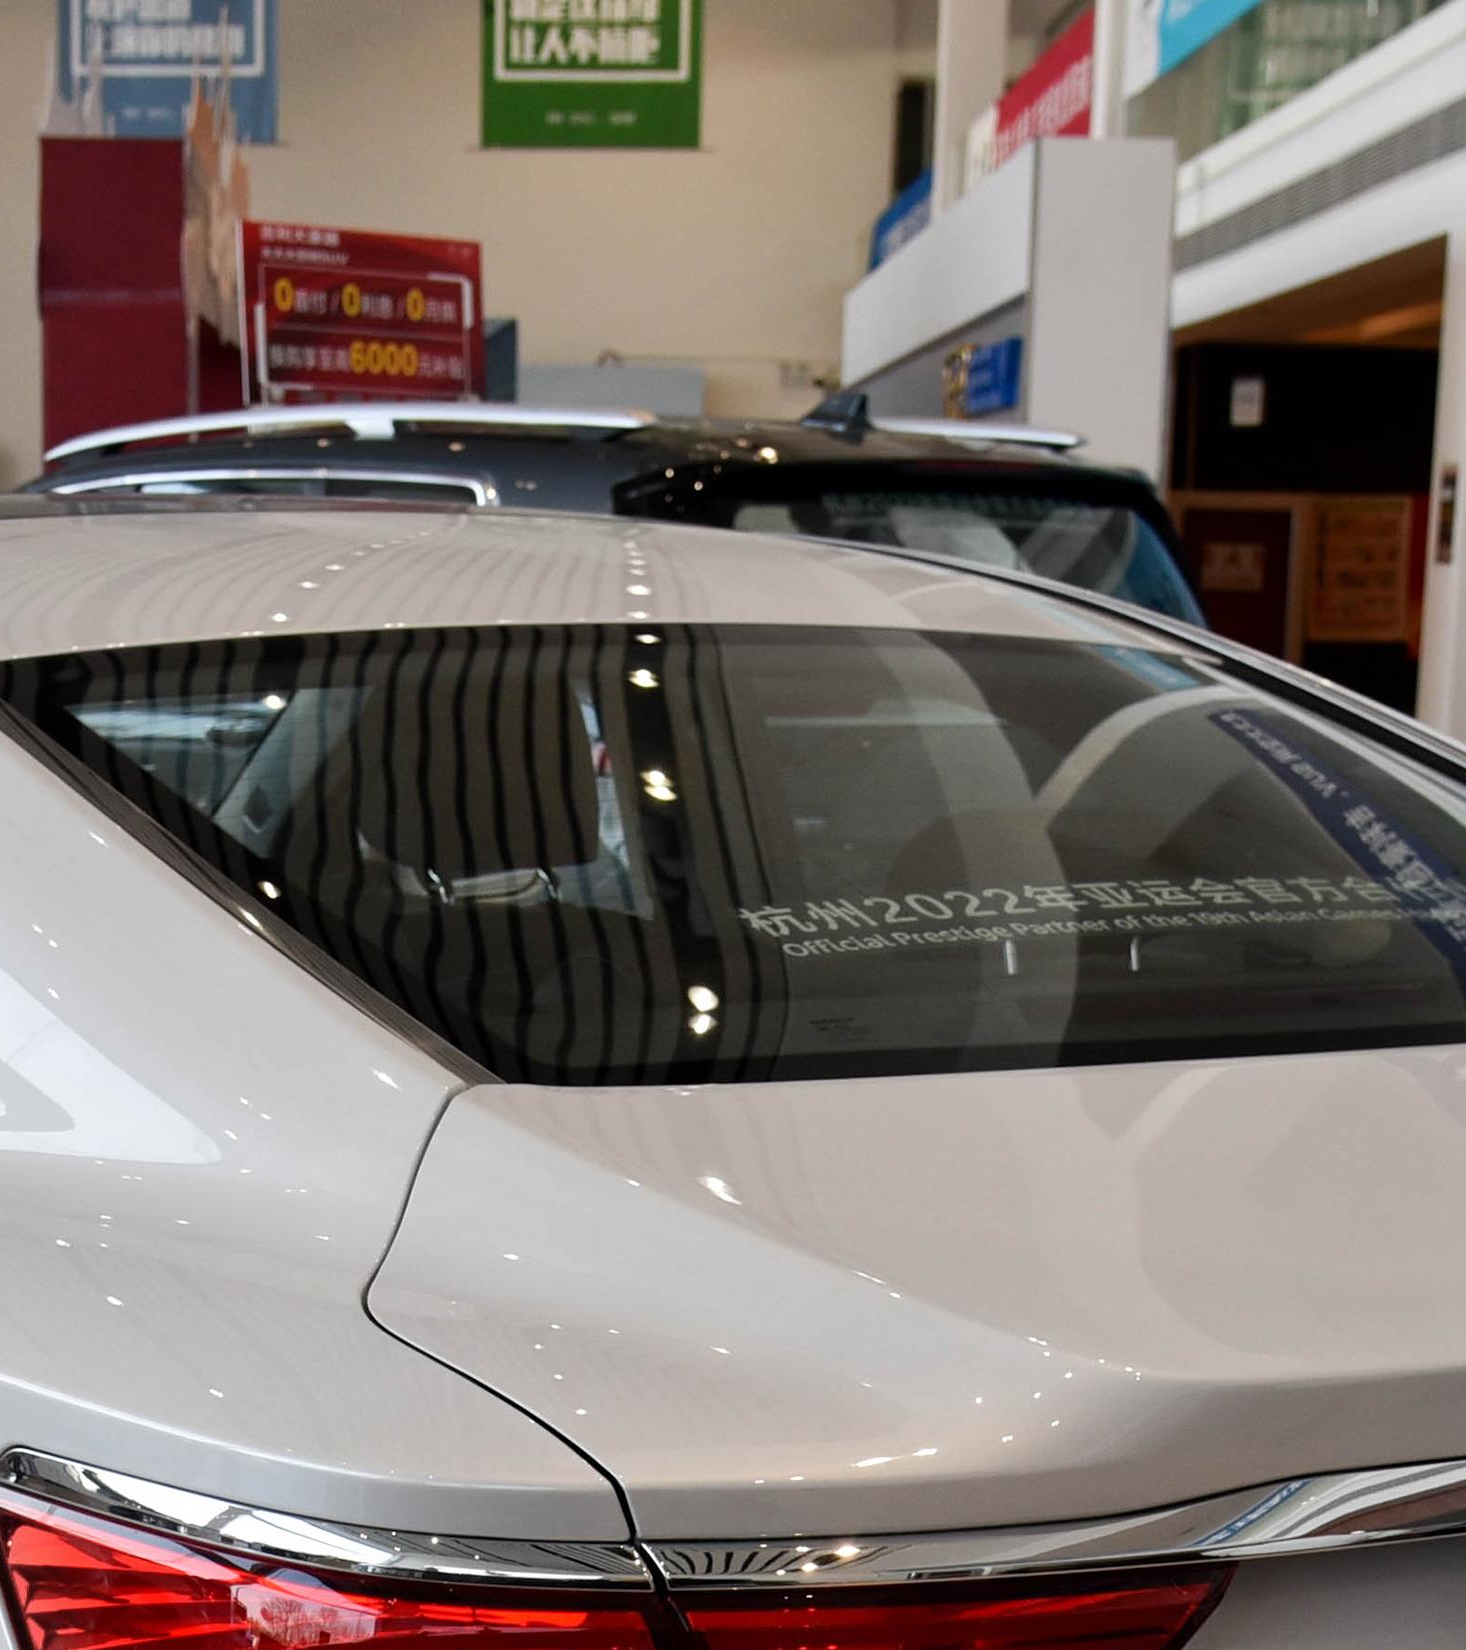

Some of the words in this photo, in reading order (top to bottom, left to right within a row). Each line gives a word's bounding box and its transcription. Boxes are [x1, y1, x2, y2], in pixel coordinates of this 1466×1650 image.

[781, 931, 895, 958] Official
[894, 923, 1013, 947] Prestige
[1015, 914, 1113, 937] Partner
[1114, 911, 1142, 931] of
[1147, 909, 1191, 929] the
